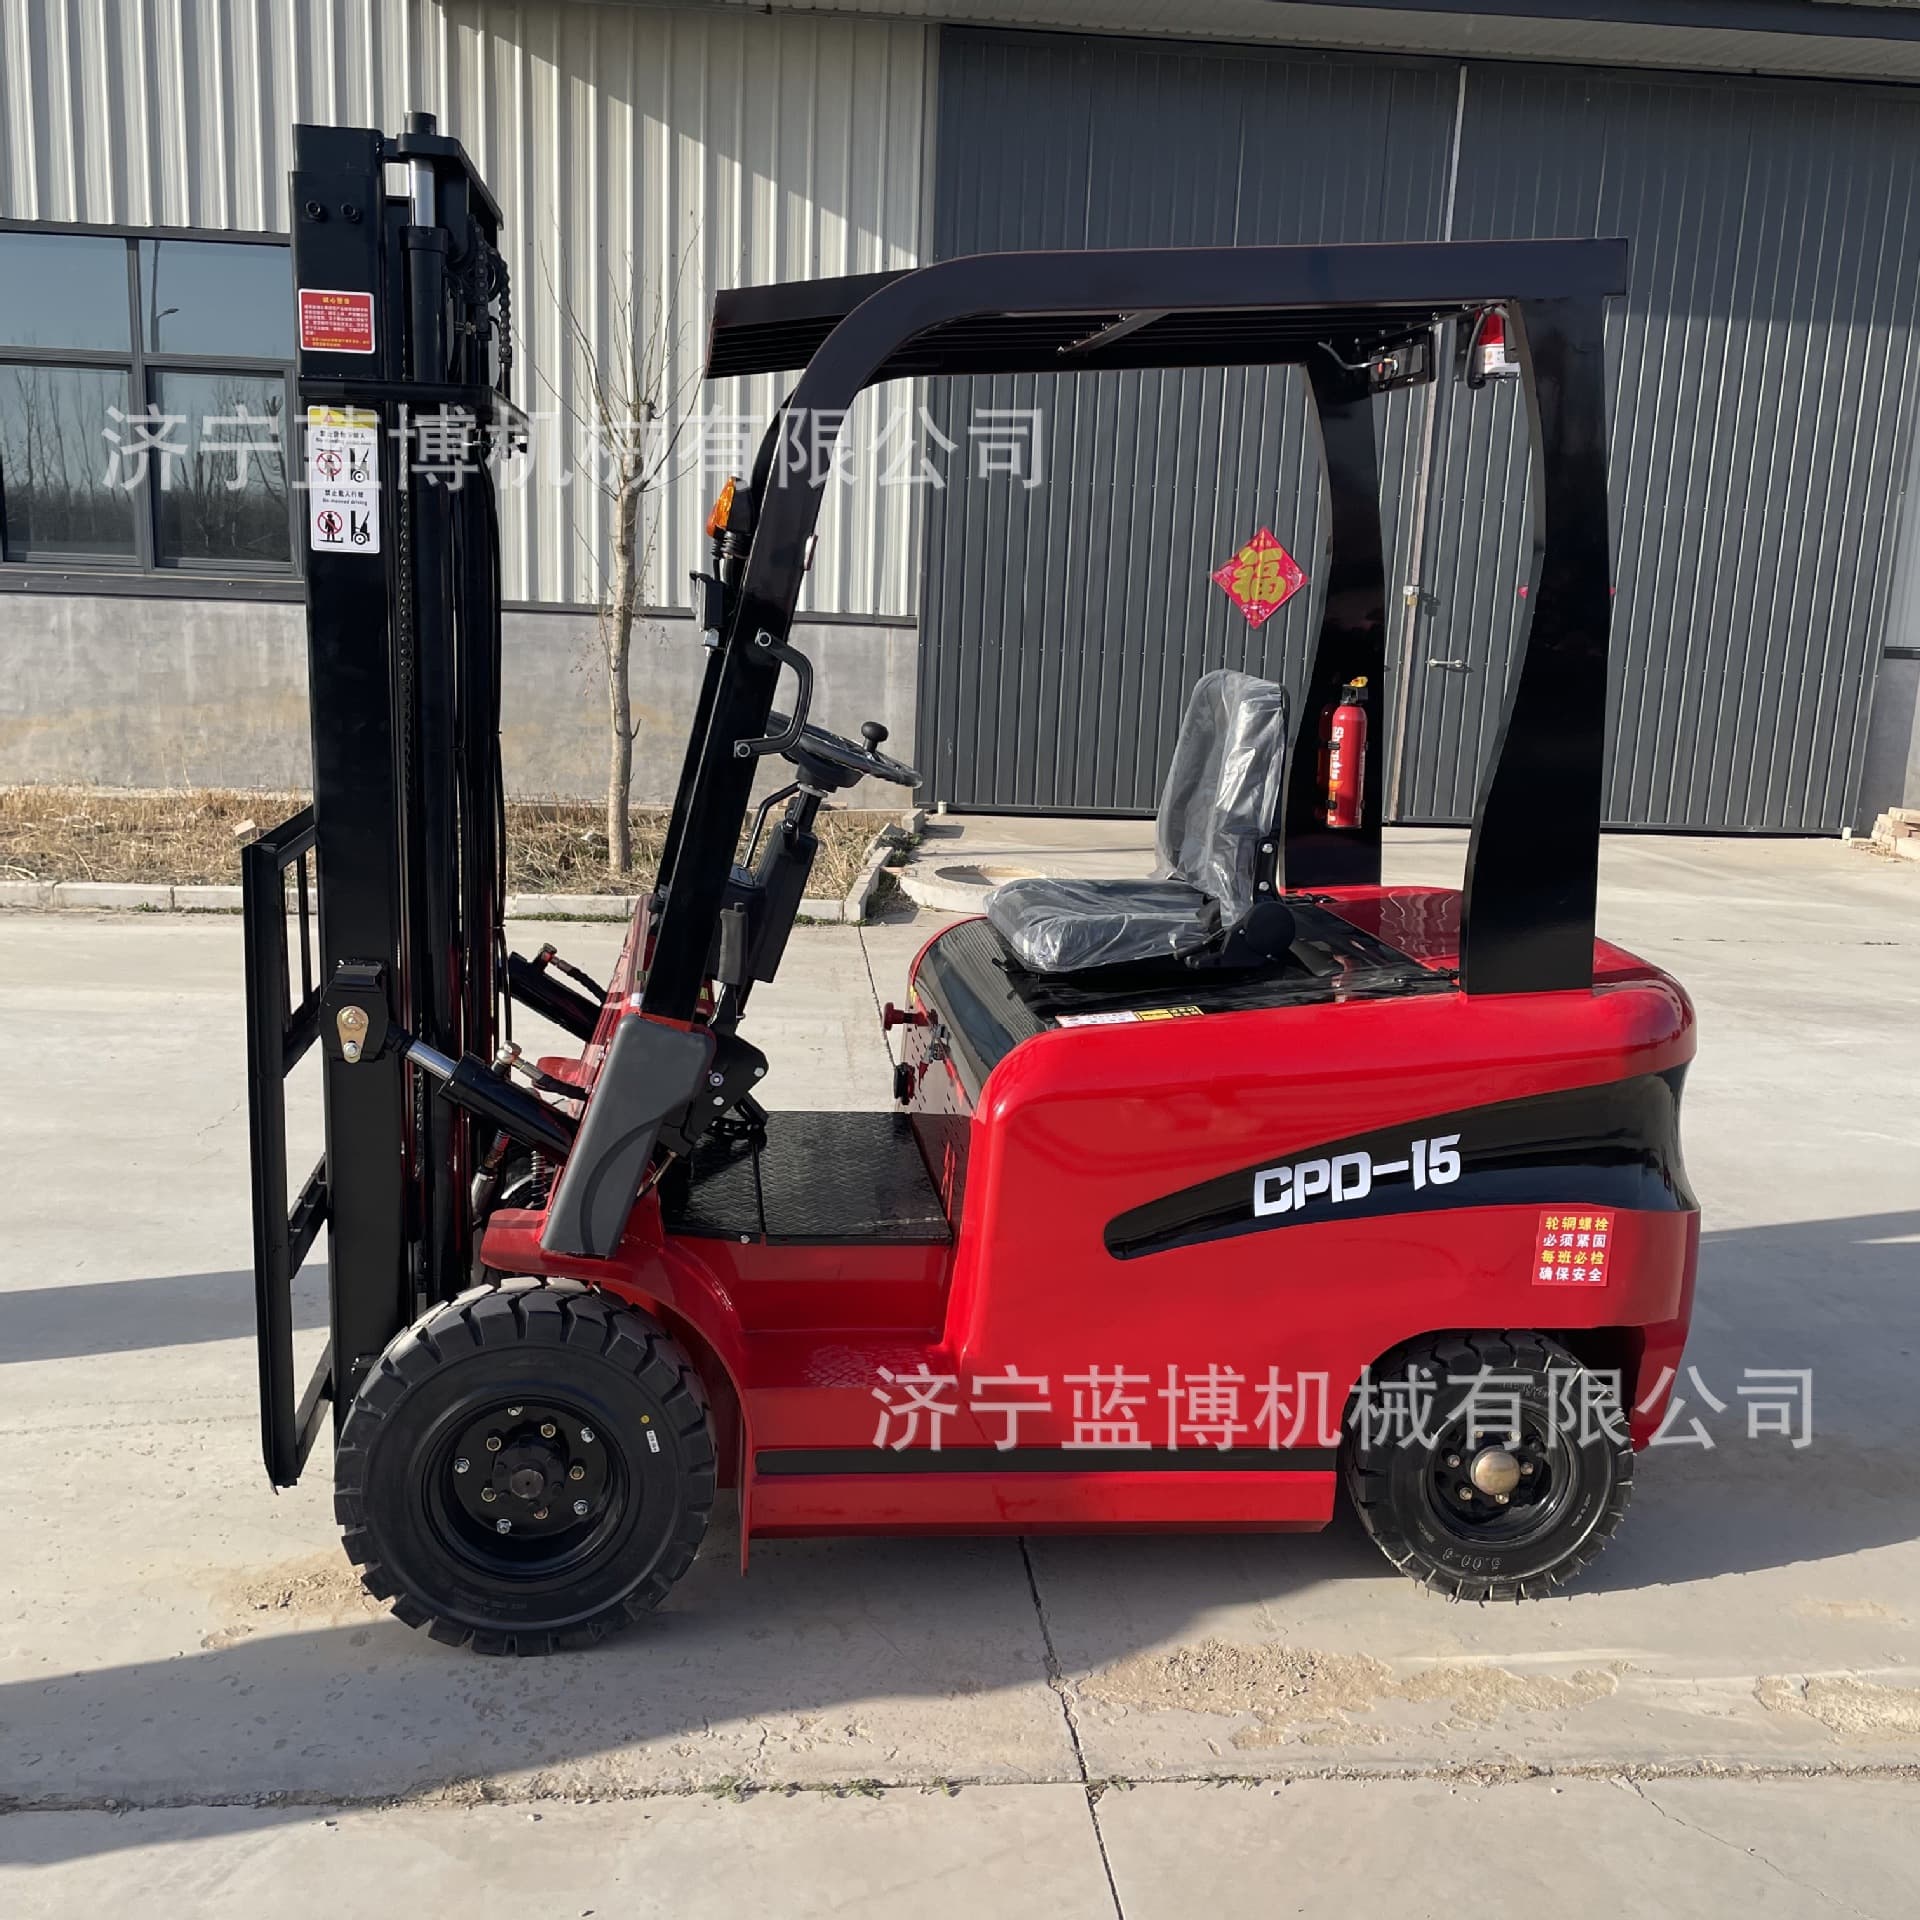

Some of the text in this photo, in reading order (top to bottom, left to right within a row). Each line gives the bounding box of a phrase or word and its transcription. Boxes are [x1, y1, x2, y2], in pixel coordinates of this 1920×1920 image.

[1231, 546, 1287, 604] 福
[1254, 1133, 1461, 1218] CPD-15
[1543, 1233, 1607, 1248] 必须紧固
[1541, 1249, 1605, 1264] 每班必检
[1539, 1266, 1602, 1281] 确保安全
